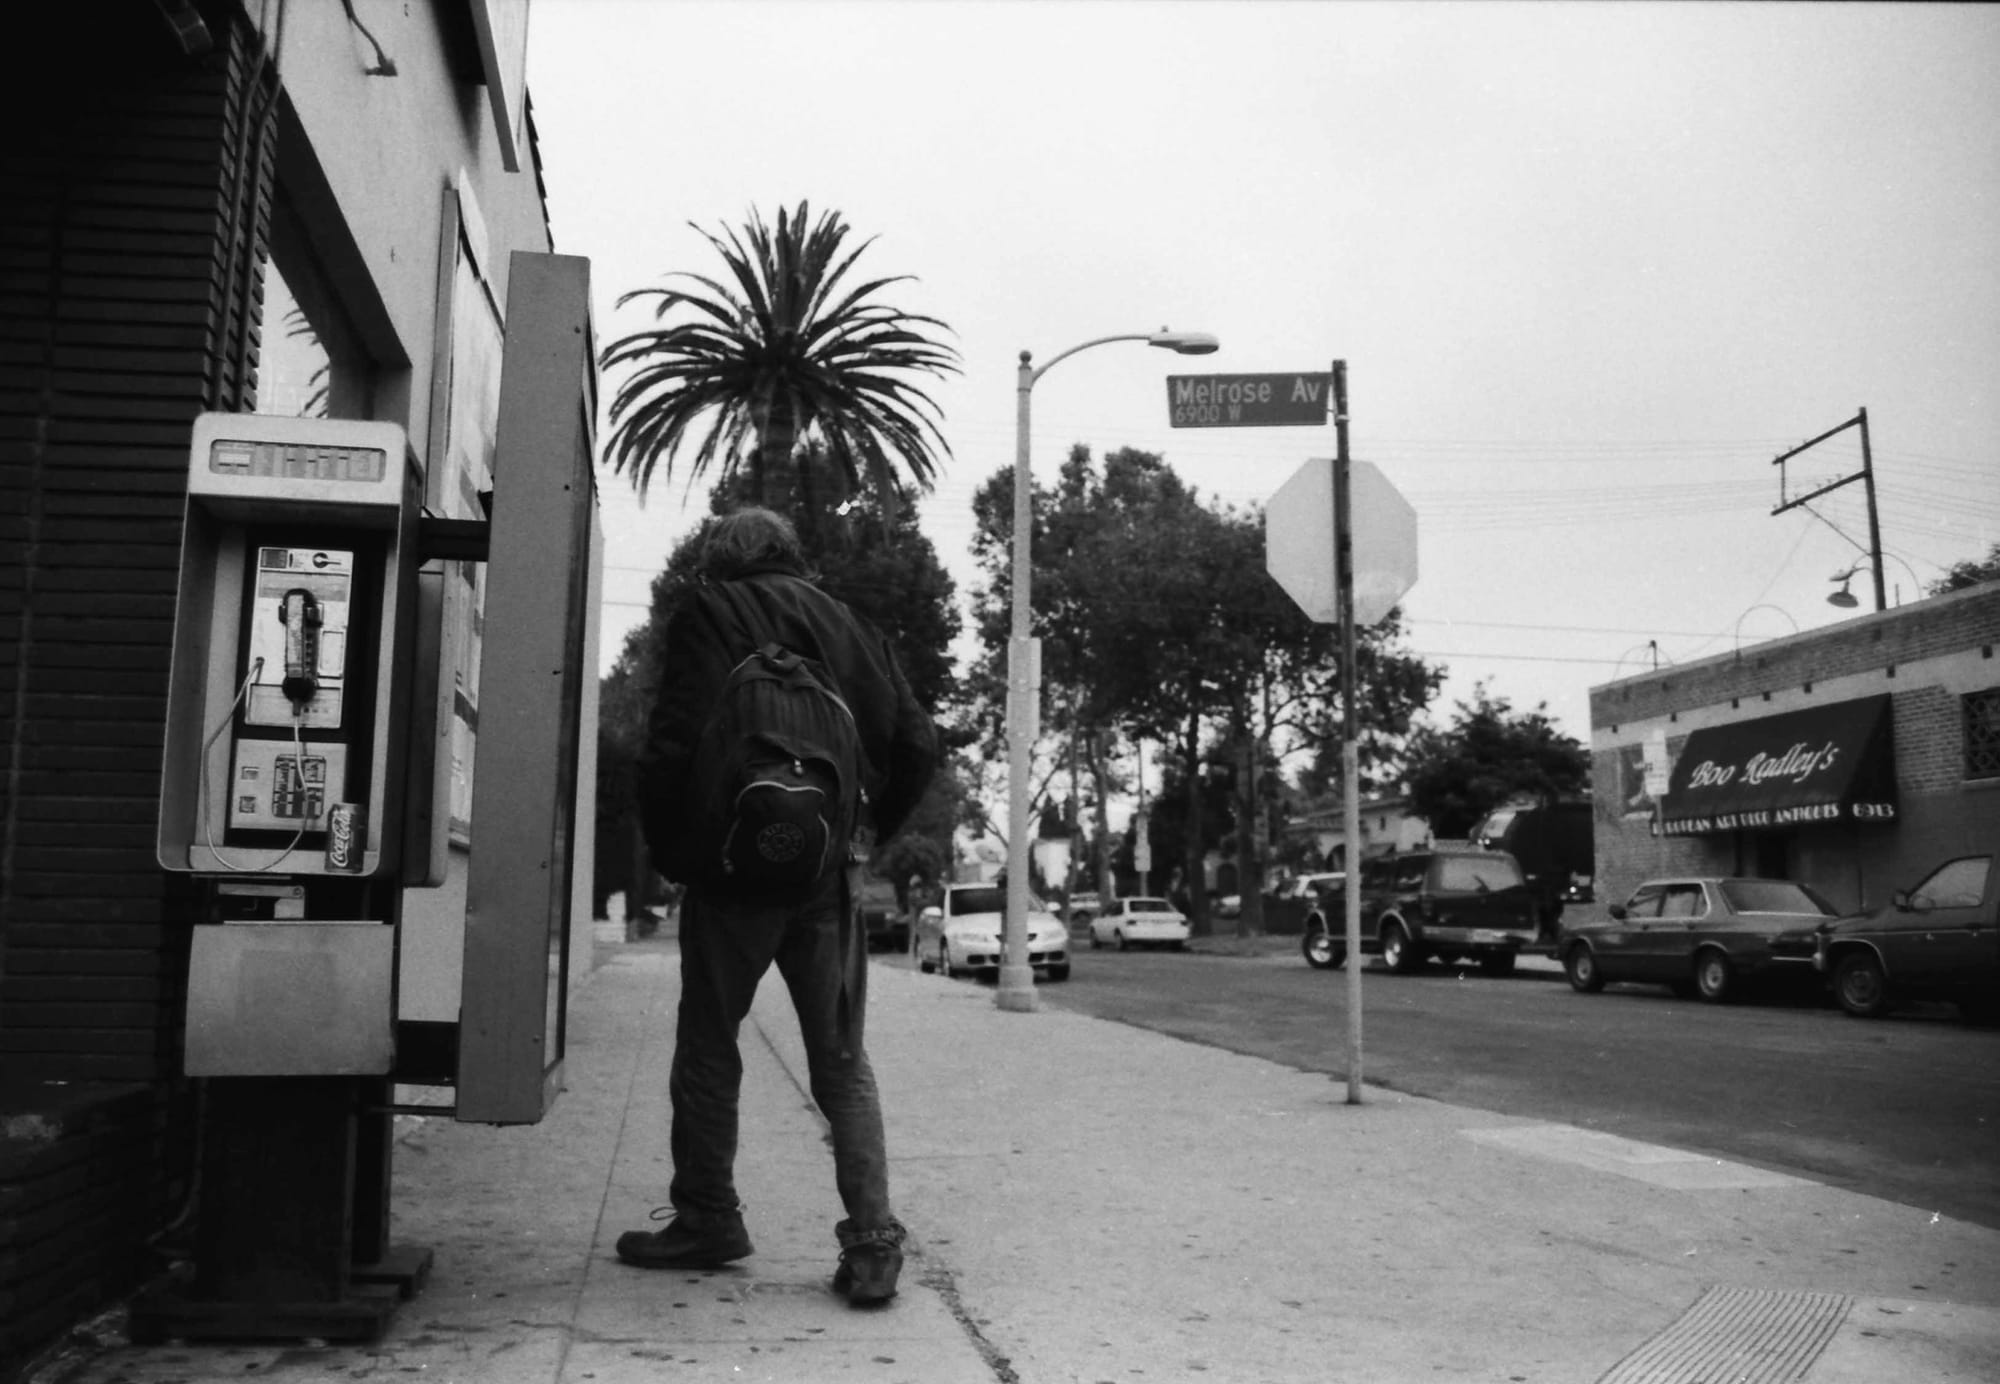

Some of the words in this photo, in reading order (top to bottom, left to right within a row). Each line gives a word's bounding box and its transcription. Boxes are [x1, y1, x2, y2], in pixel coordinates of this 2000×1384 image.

[1175, 379, 1271, 404] Melrose
[1291, 377, 1321, 402] Av
[1175, 405, 1220, 423] 6900
[1229, 404, 1241, 421] W
[1688, 760, 1736, 789] Boo
[1738, 741, 1839, 785] Radley's
[1775, 803, 1839, 823] ANTIQUES
[1852, 803, 1894, 818] 6913
